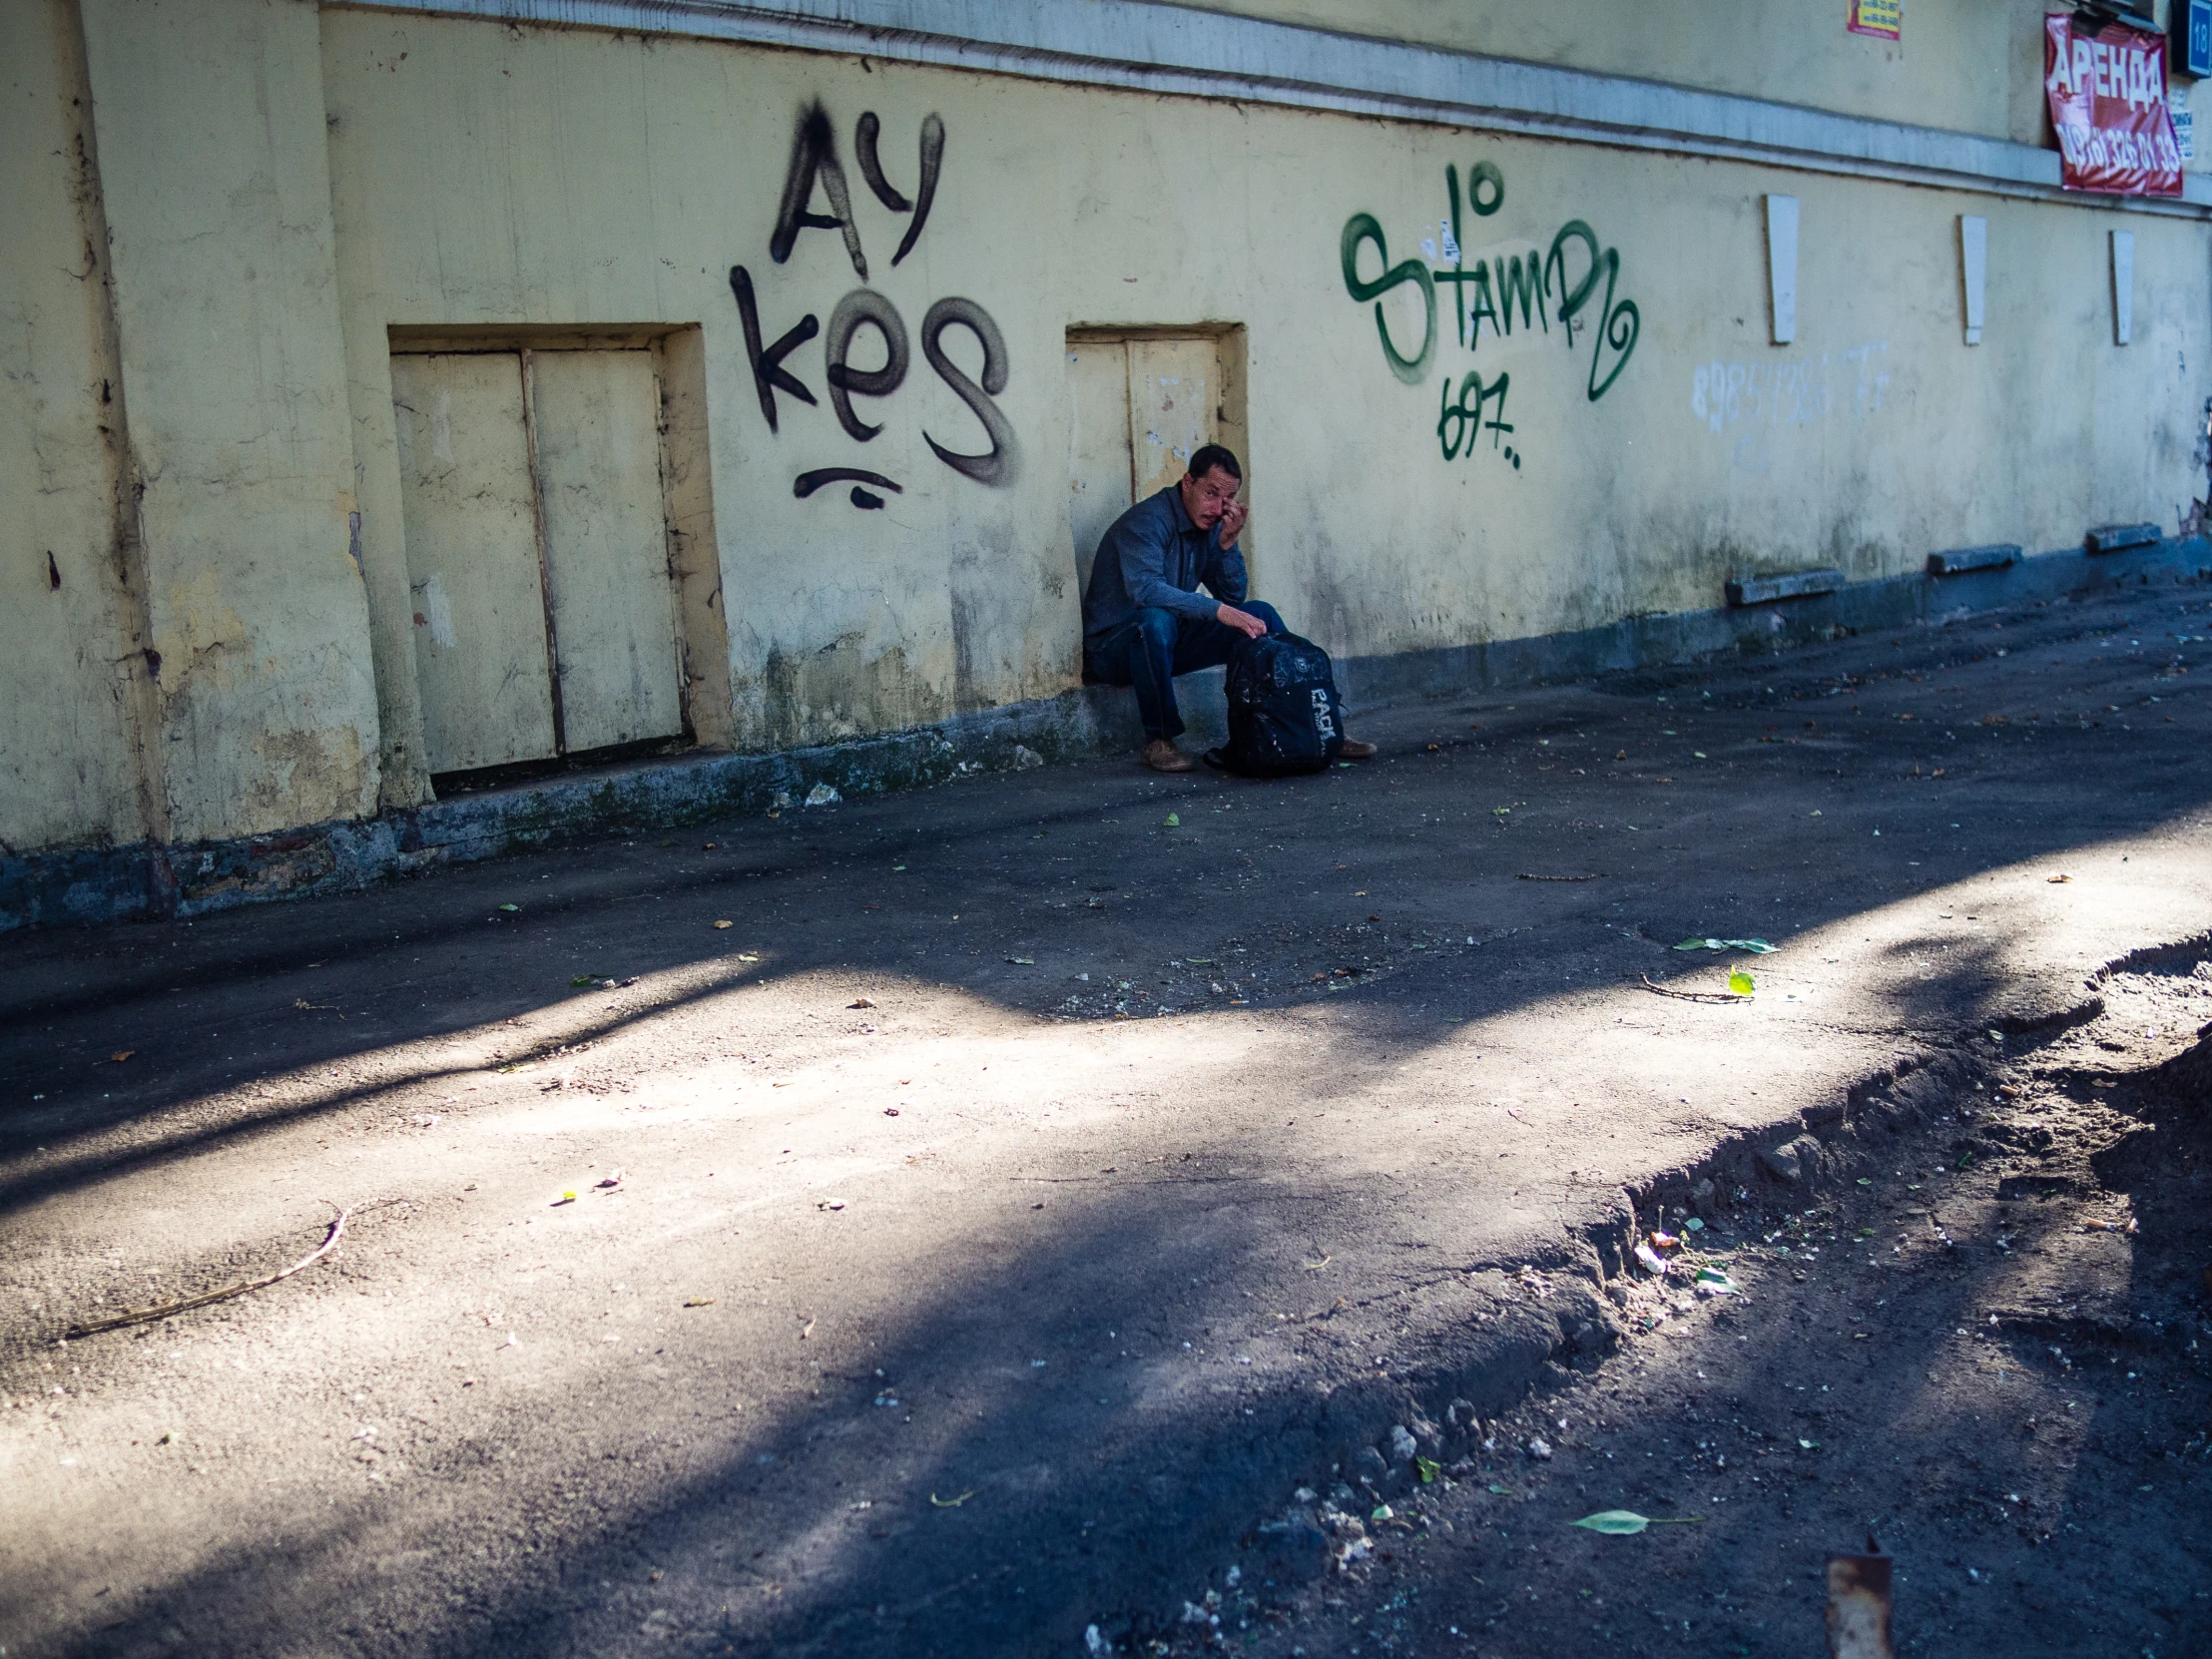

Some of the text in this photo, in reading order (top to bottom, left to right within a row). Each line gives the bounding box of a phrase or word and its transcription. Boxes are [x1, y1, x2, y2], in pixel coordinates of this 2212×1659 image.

[2194, 21, 2207, 54] 18
[2047, 34, 2164, 113] АРЕНДА
[2156, 134, 2181, 173] 33
